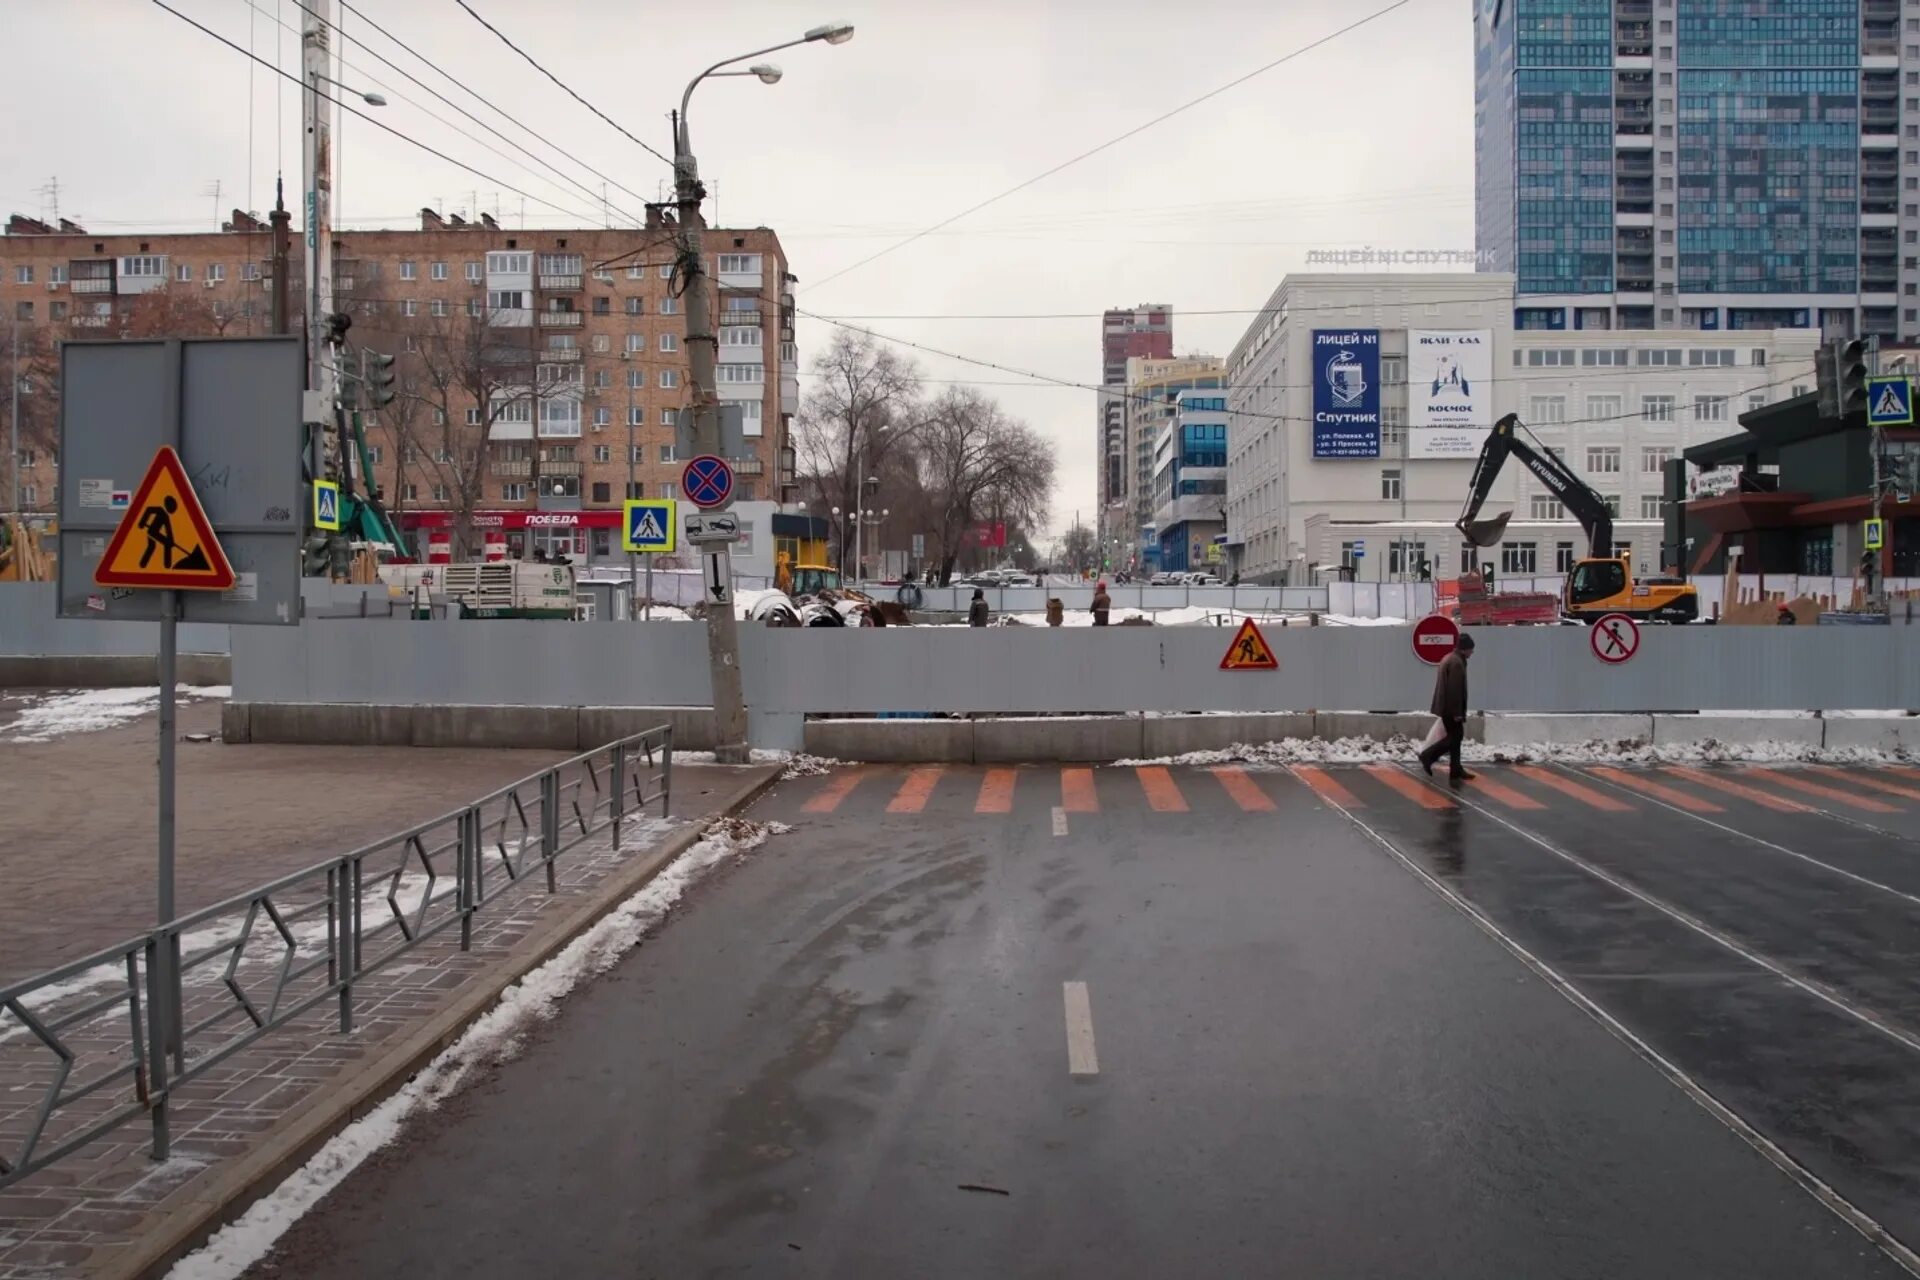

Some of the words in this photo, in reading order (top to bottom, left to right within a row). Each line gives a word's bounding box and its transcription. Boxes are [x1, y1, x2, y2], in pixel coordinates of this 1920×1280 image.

[1305, 246, 1374, 266] ЛИЦЕЙ
[1402, 250, 1497, 264] СПУТНИК
[1316, 332, 1359, 346] ЛИЦЕЙ
[1427, 405, 1473, 413] КОСМОС
[1316, 412, 1377, 425] Спутник
[1530, 459, 1567, 492] HYUNDAI
[525, 515, 579, 525] ПОБЕДА
